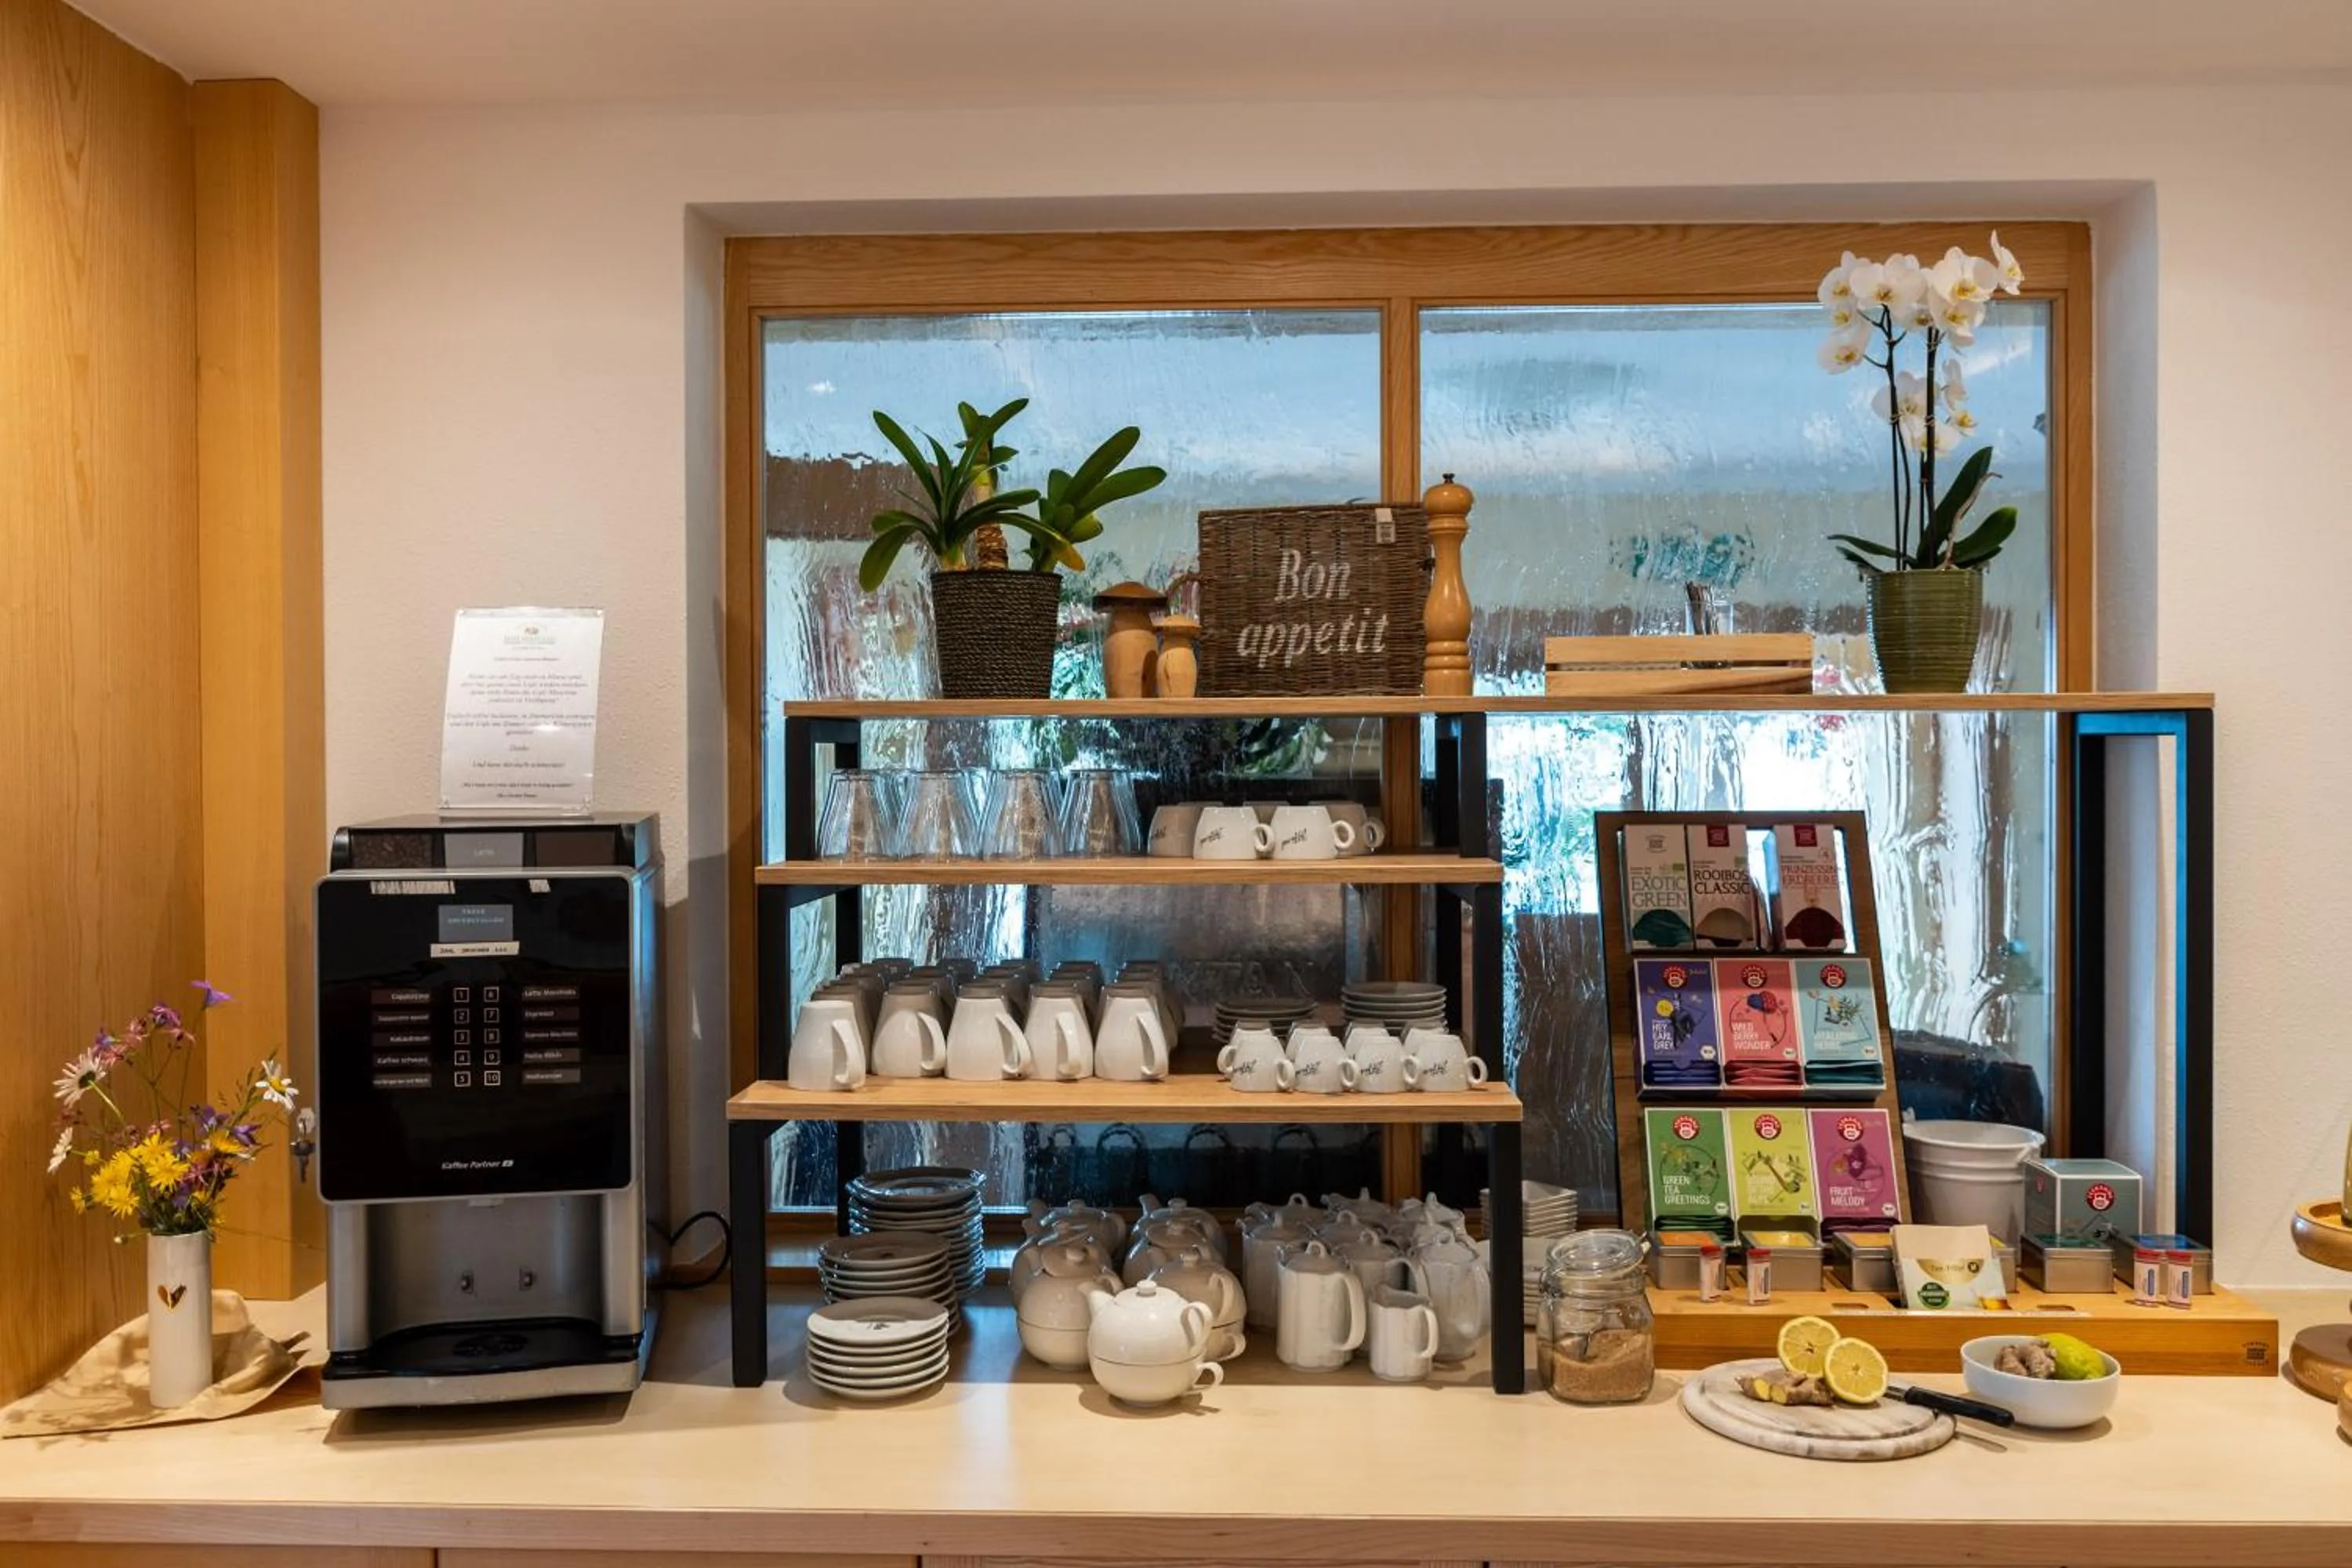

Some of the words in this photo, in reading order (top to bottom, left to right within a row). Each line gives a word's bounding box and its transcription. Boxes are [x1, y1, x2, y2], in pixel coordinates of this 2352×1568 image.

[1273, 548, 1351, 602] Bon
[1236, 608, 1389, 669] appetit
[1693, 869, 1749, 880] ROOIBOS
[1631, 876, 1686, 891] EXOTIC
[1694, 882, 1751, 895] CLASSIC
[1632, 891, 1688, 908] GREEN
[1734, 1040, 1770, 1050] WONDER
[487, 1073, 499, 1083] 10
[470, 1160, 501, 1169] Partner
[1663, 1175, 1690, 1185] GREEN
[1664, 1185, 1680, 1194] TEA
[1829, 1186, 1853, 1196] FRUIT
[1664, 1194, 1711, 1205] GREETINGS
[1831, 1196, 1865, 1207] MELODY
